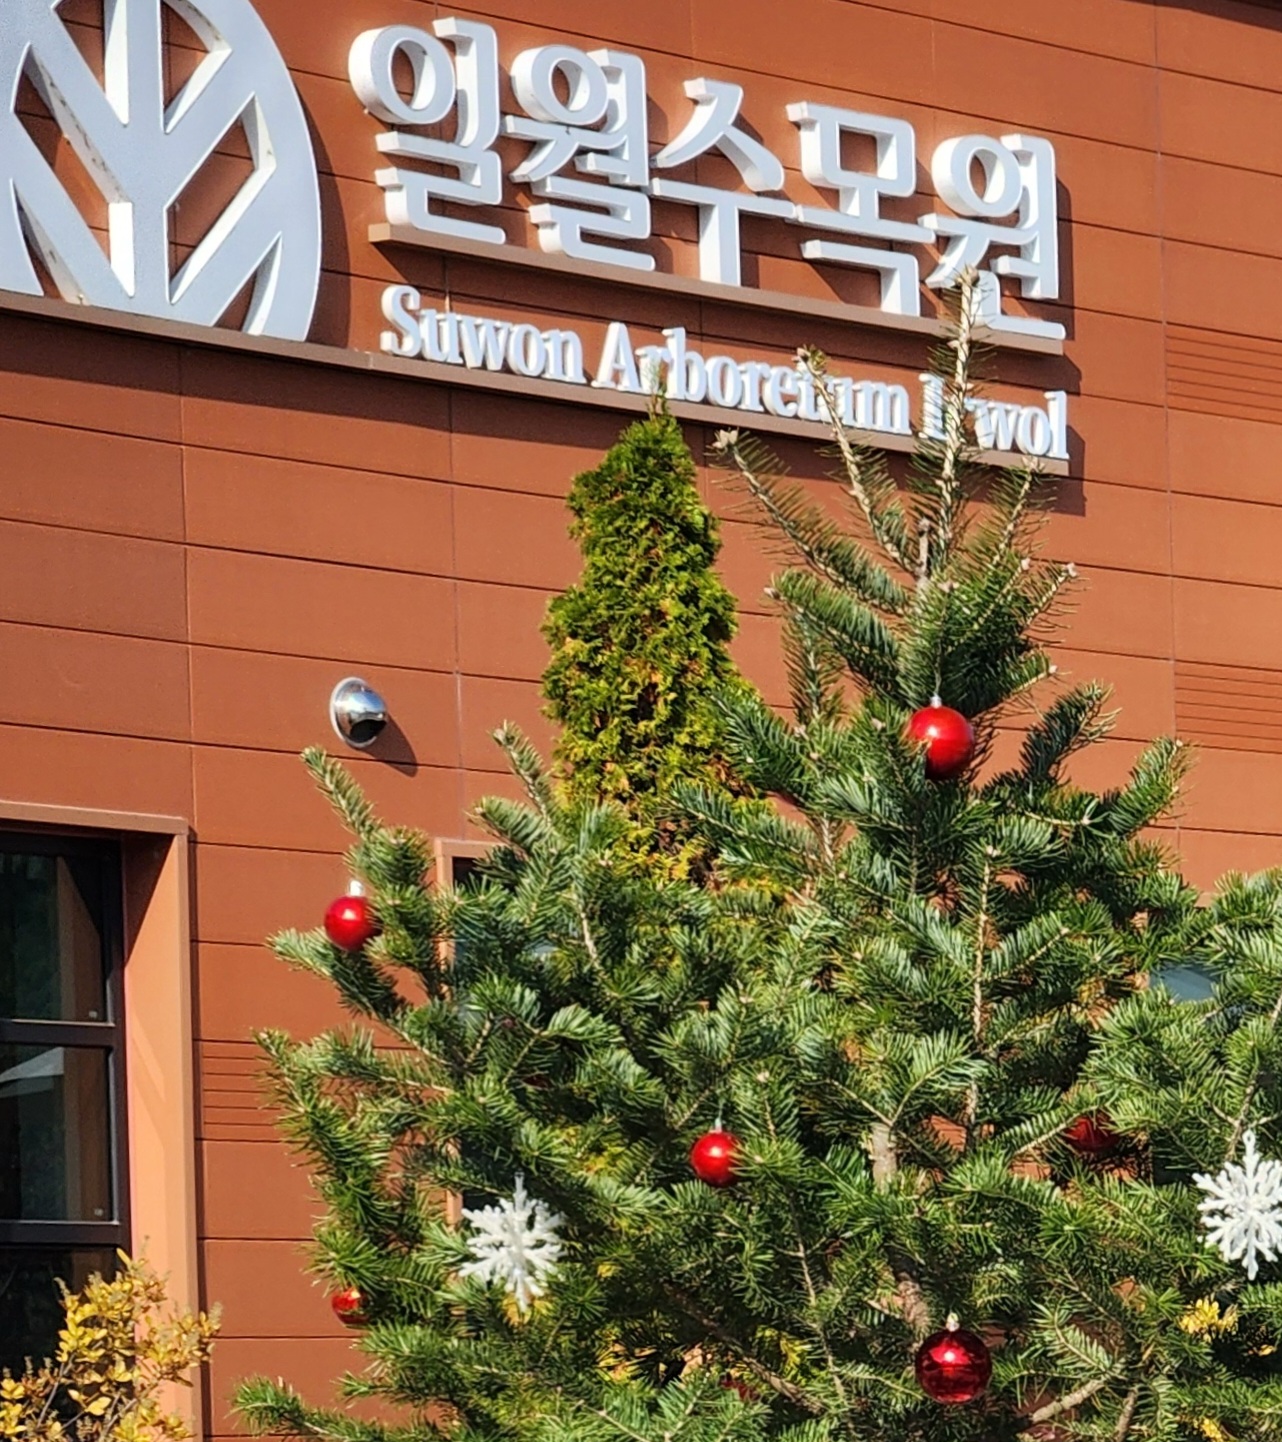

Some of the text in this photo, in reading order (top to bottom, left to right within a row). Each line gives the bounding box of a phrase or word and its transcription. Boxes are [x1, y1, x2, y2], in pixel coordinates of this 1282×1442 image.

[348, 17, 1066, 340] 일월수목원
[379, 284, 1070, 460] Suwon Arboretum Iwol
